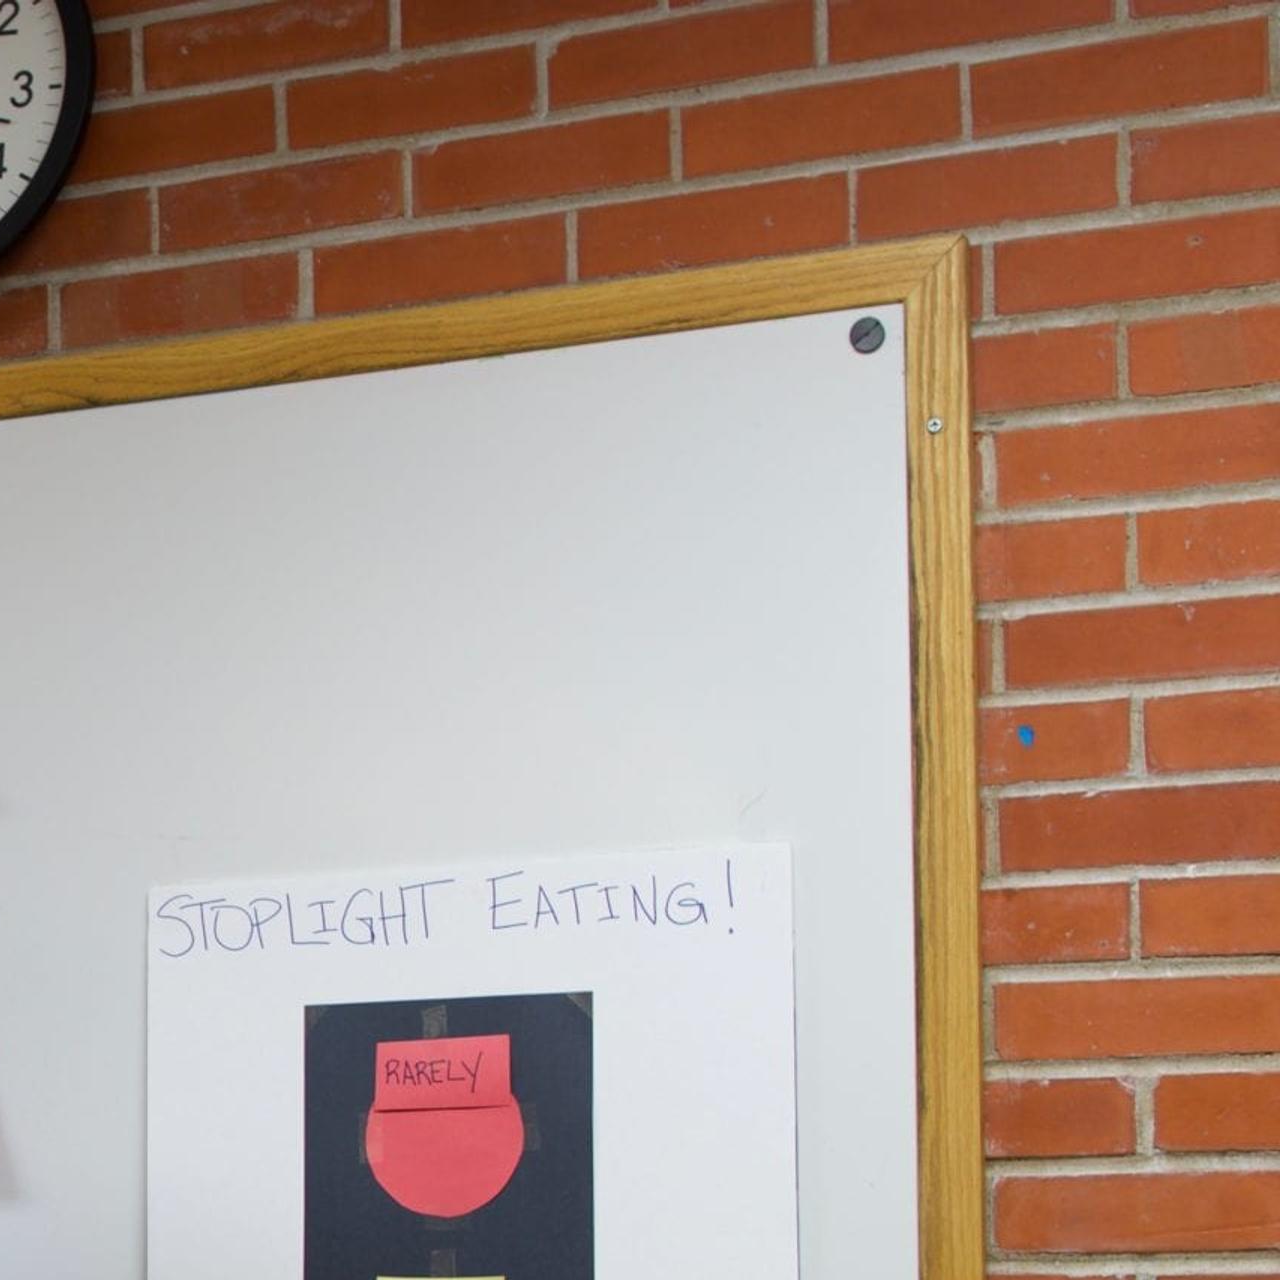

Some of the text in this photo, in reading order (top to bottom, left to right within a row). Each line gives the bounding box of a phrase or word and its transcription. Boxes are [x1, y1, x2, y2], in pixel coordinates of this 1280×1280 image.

[10, 69, 34, 108] 3
[156, 858, 736, 957] STOPLIGHT EATING!
[384, 1050, 485, 1094] RARELY
